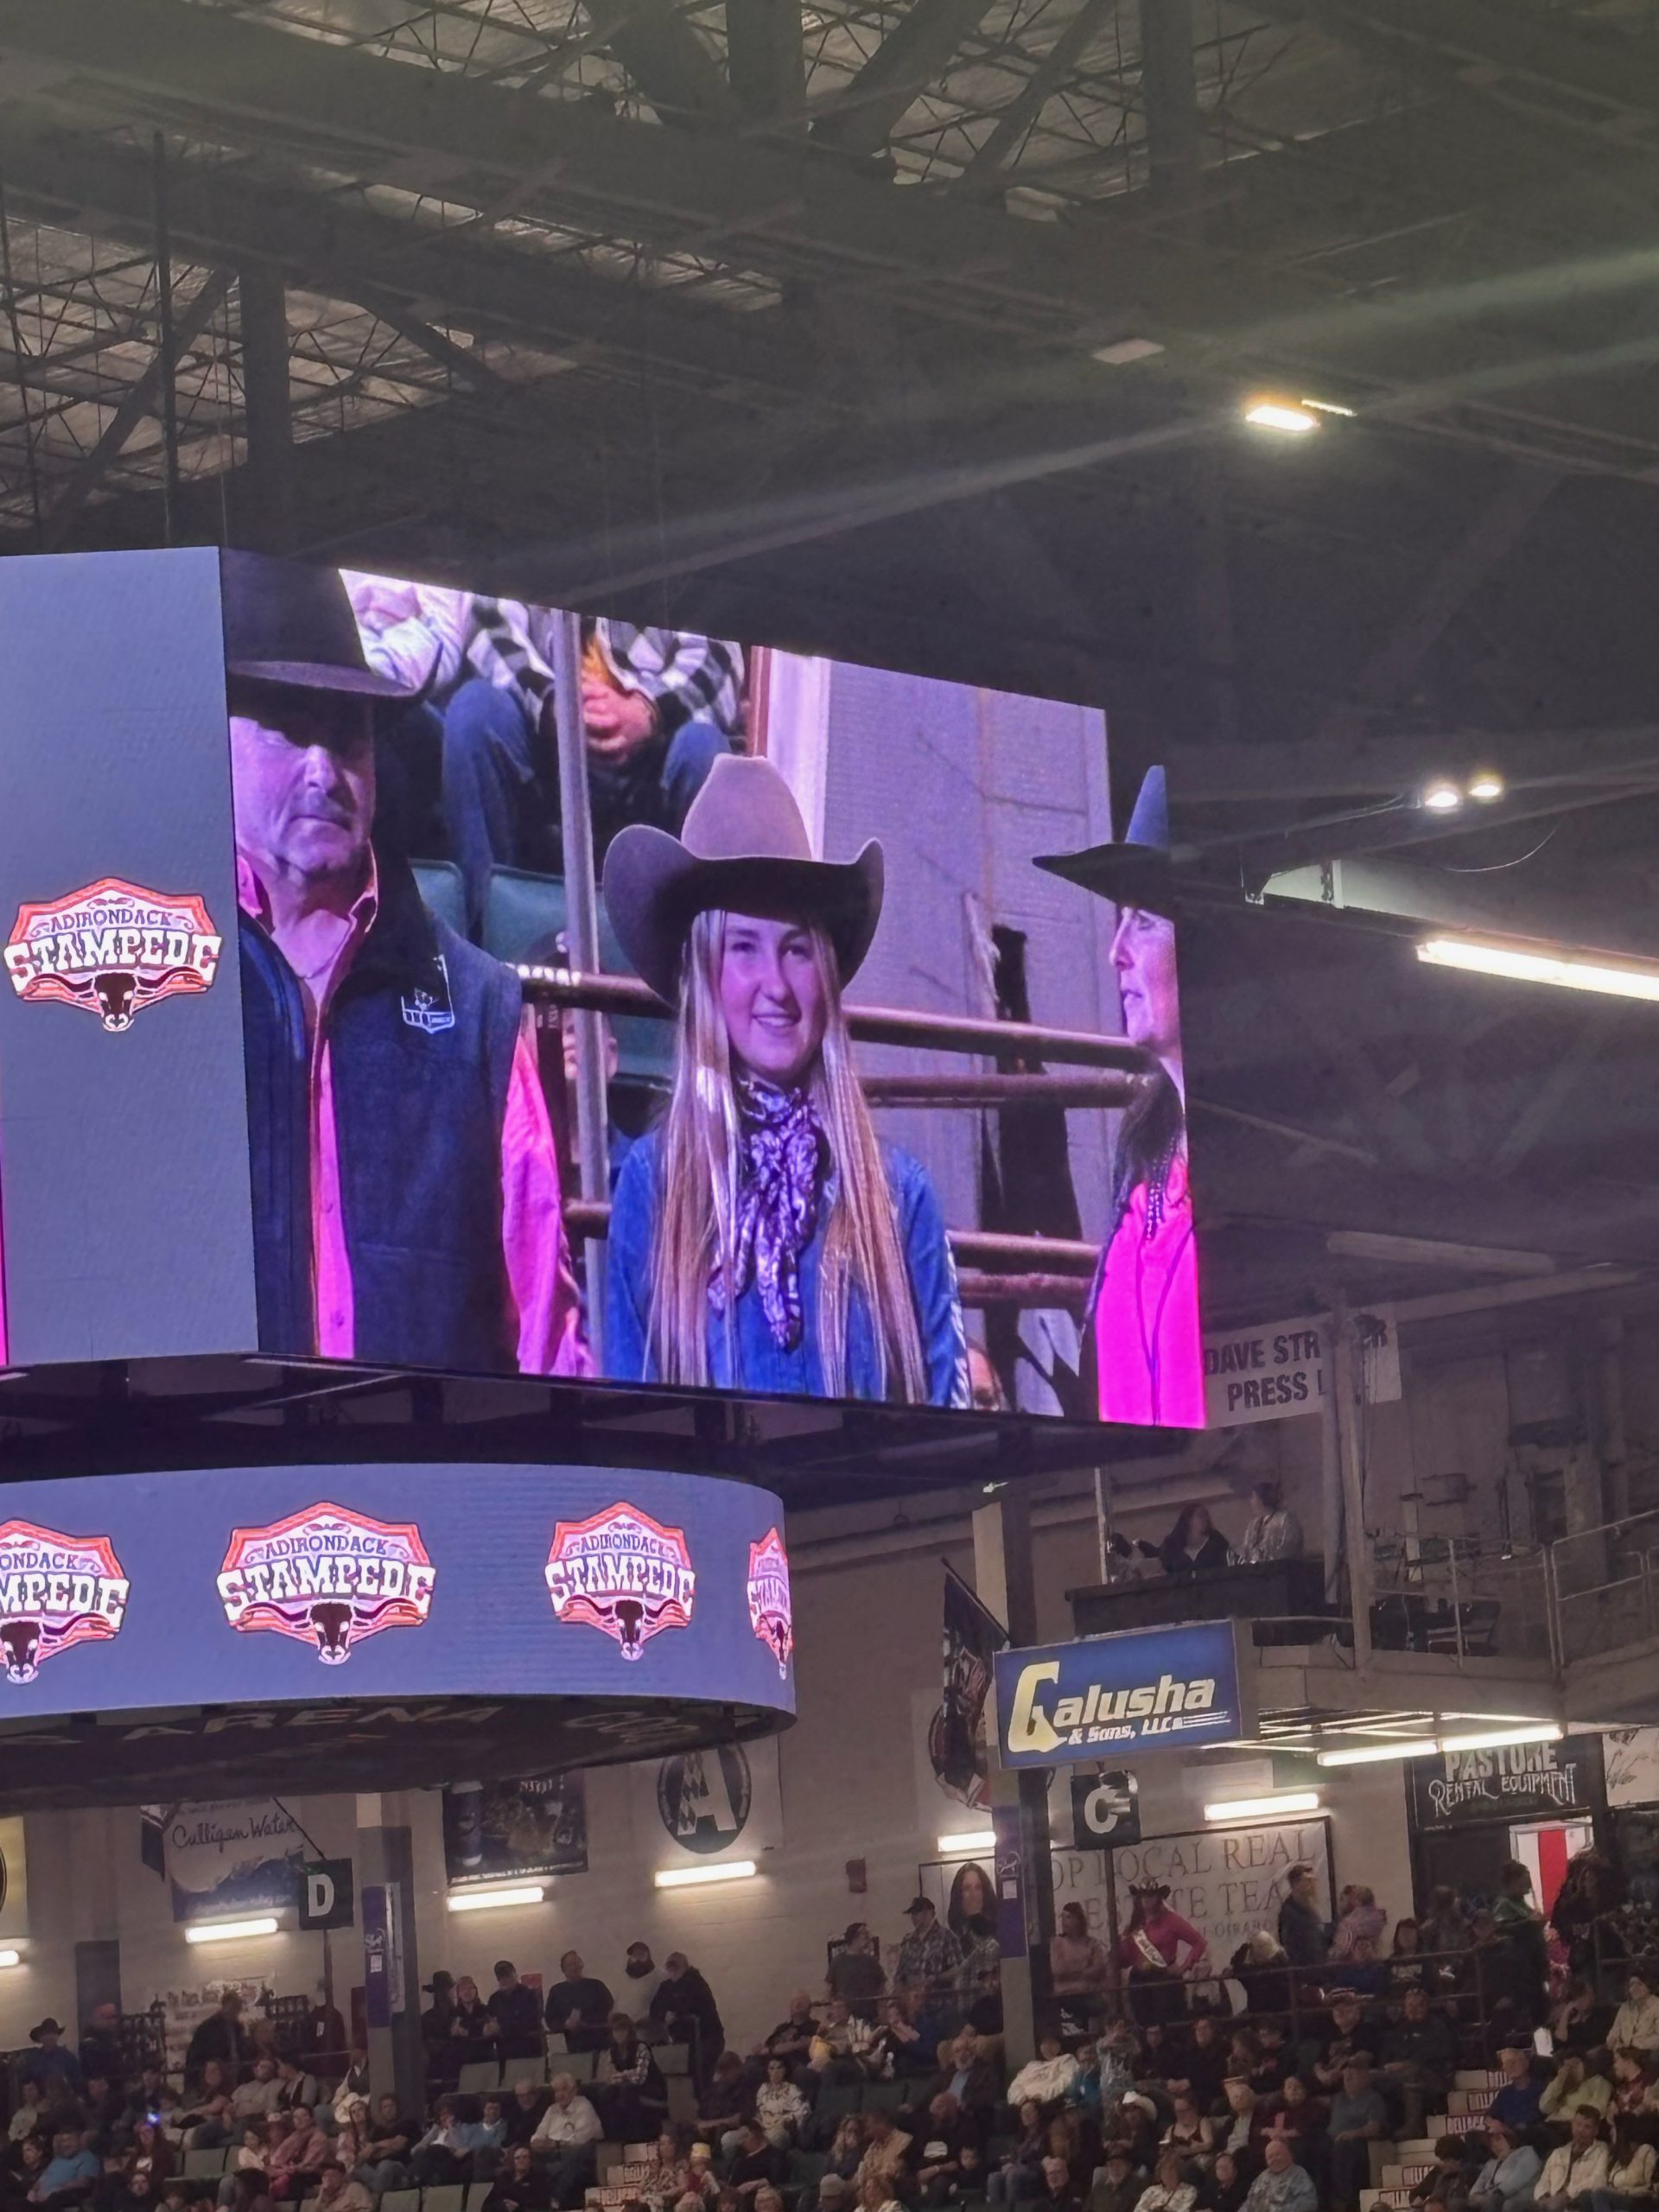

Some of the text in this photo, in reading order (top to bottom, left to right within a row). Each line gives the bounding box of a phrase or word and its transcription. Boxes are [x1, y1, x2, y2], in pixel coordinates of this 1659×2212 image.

[51, 909, 173, 932] ADIRONDACK
[4, 927, 222, 993] STAMPEDE
[1205, 1330, 1321, 1376] DAVE STR
[1228, 1371, 1308, 1411] PRESS
[0, 1552, 79, 1571] ONDACK
[264, 1535, 387, 1560] ADIRONDACK
[580, 1534, 669, 1558] ADIRONDACK
[0, 1573, 130, 1633] MPEDE
[216, 1554, 436, 1626] STAMPEDE
[544, 1553, 696, 1617] STAMPEDE
[1007, 1661, 1216, 1752] Galusha
[1069, 1726, 1083, 1745] &
[1087, 1725, 1136, 1743] Sons,
[1052, 1828, 1315, 1891] OP LOCAL REAL
[308, 1873, 334, 1917] D
[1218, 1878, 1286, 1915] TEA
